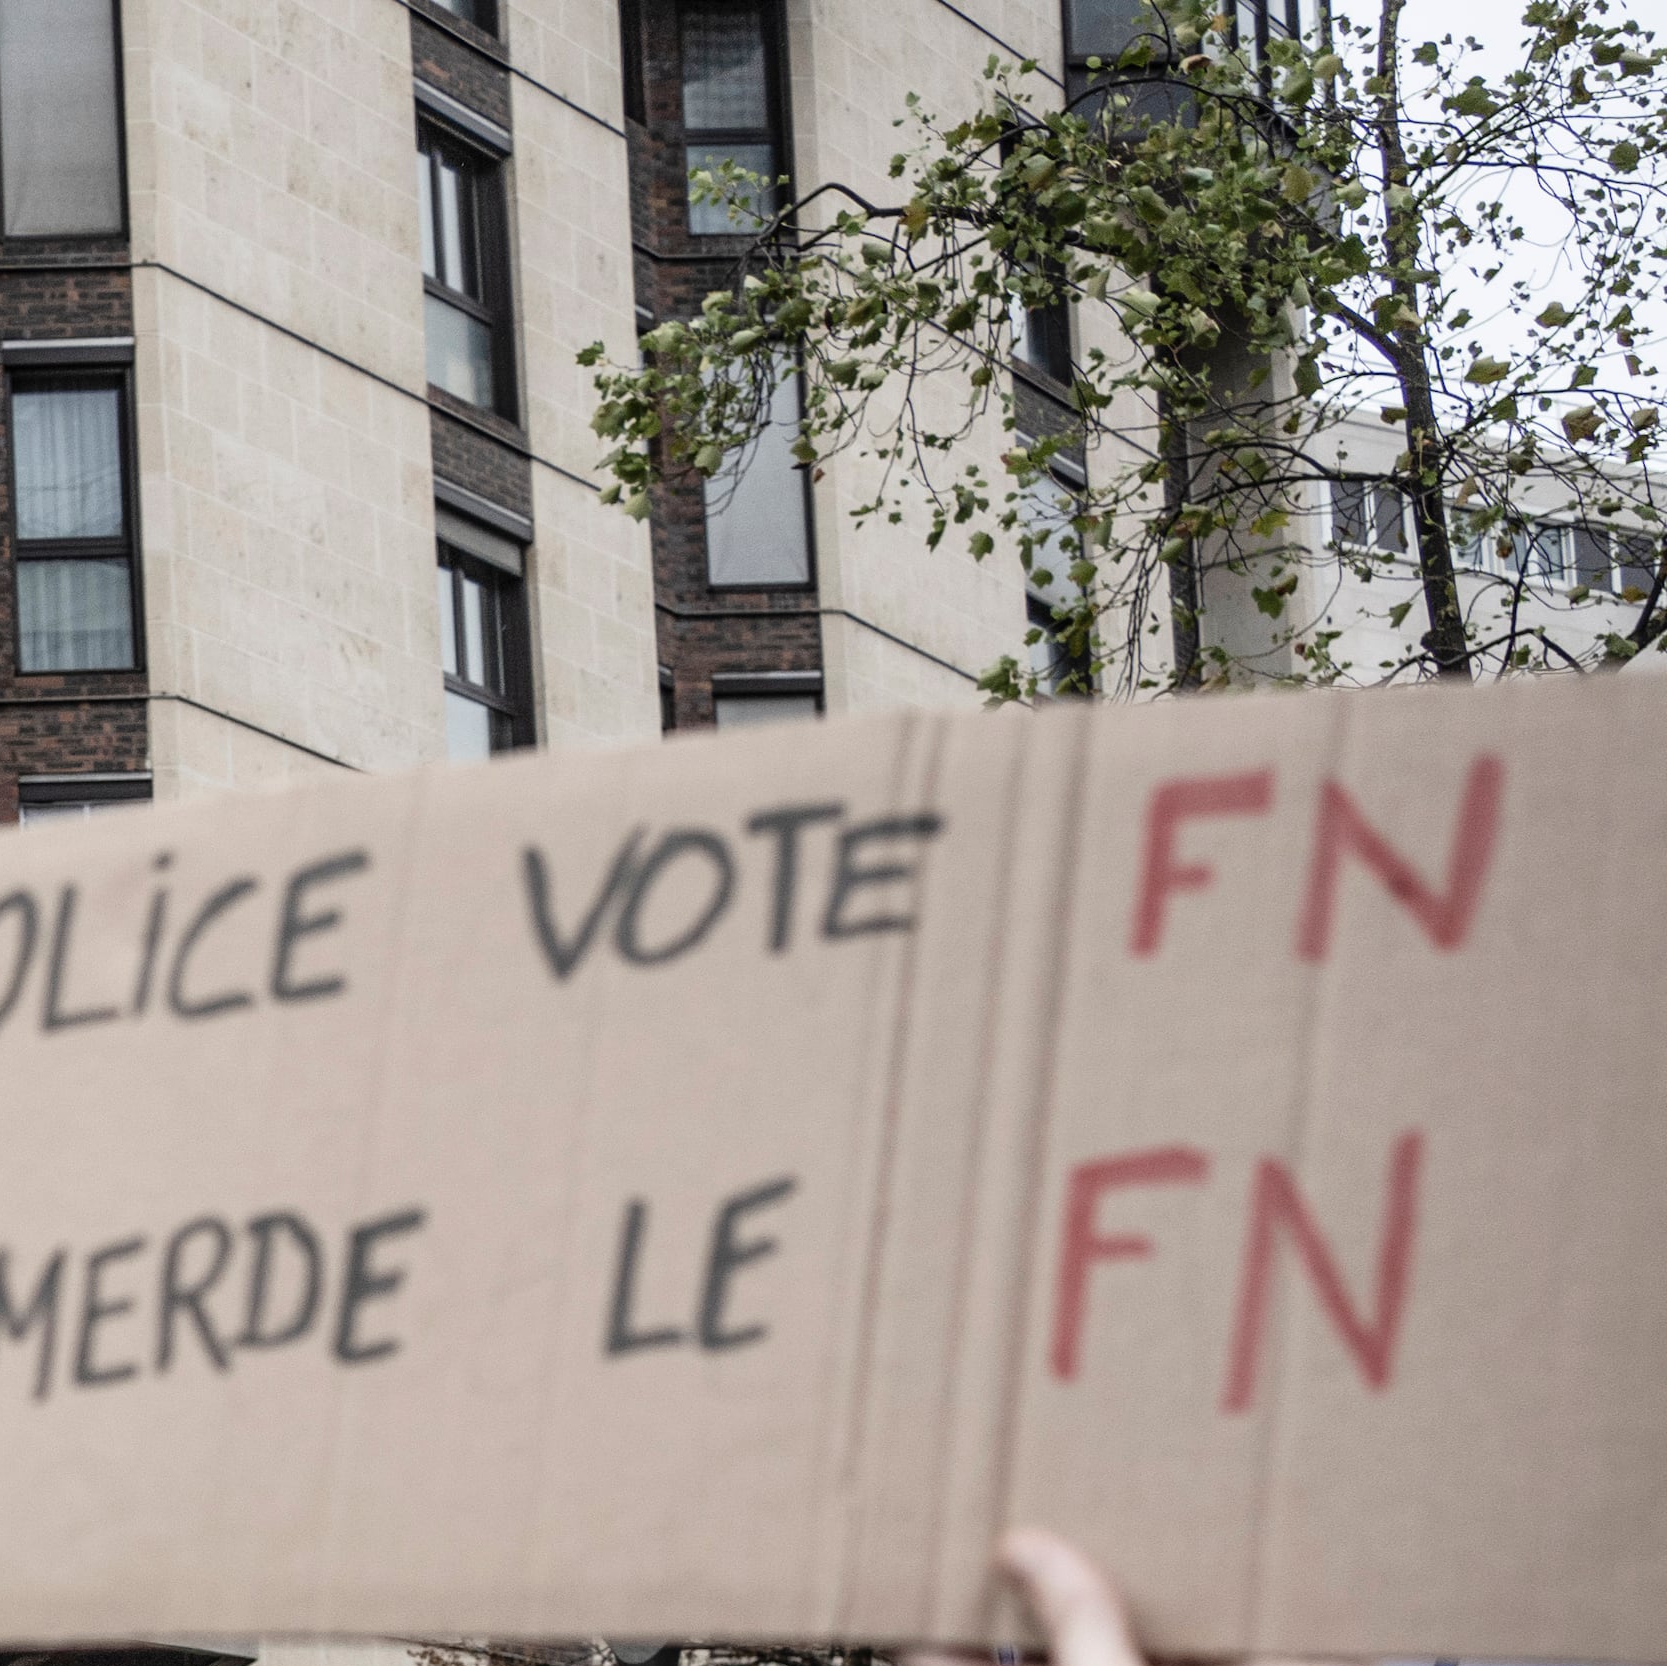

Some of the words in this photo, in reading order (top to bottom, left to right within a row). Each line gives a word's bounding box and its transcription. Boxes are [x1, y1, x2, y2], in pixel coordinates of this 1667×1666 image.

[519, 800, 945, 982] VOTE
[1126, 753, 1507, 965] FN
[601, 1174, 801, 1360] LE
[1045, 1128, 1426, 1417] FN
